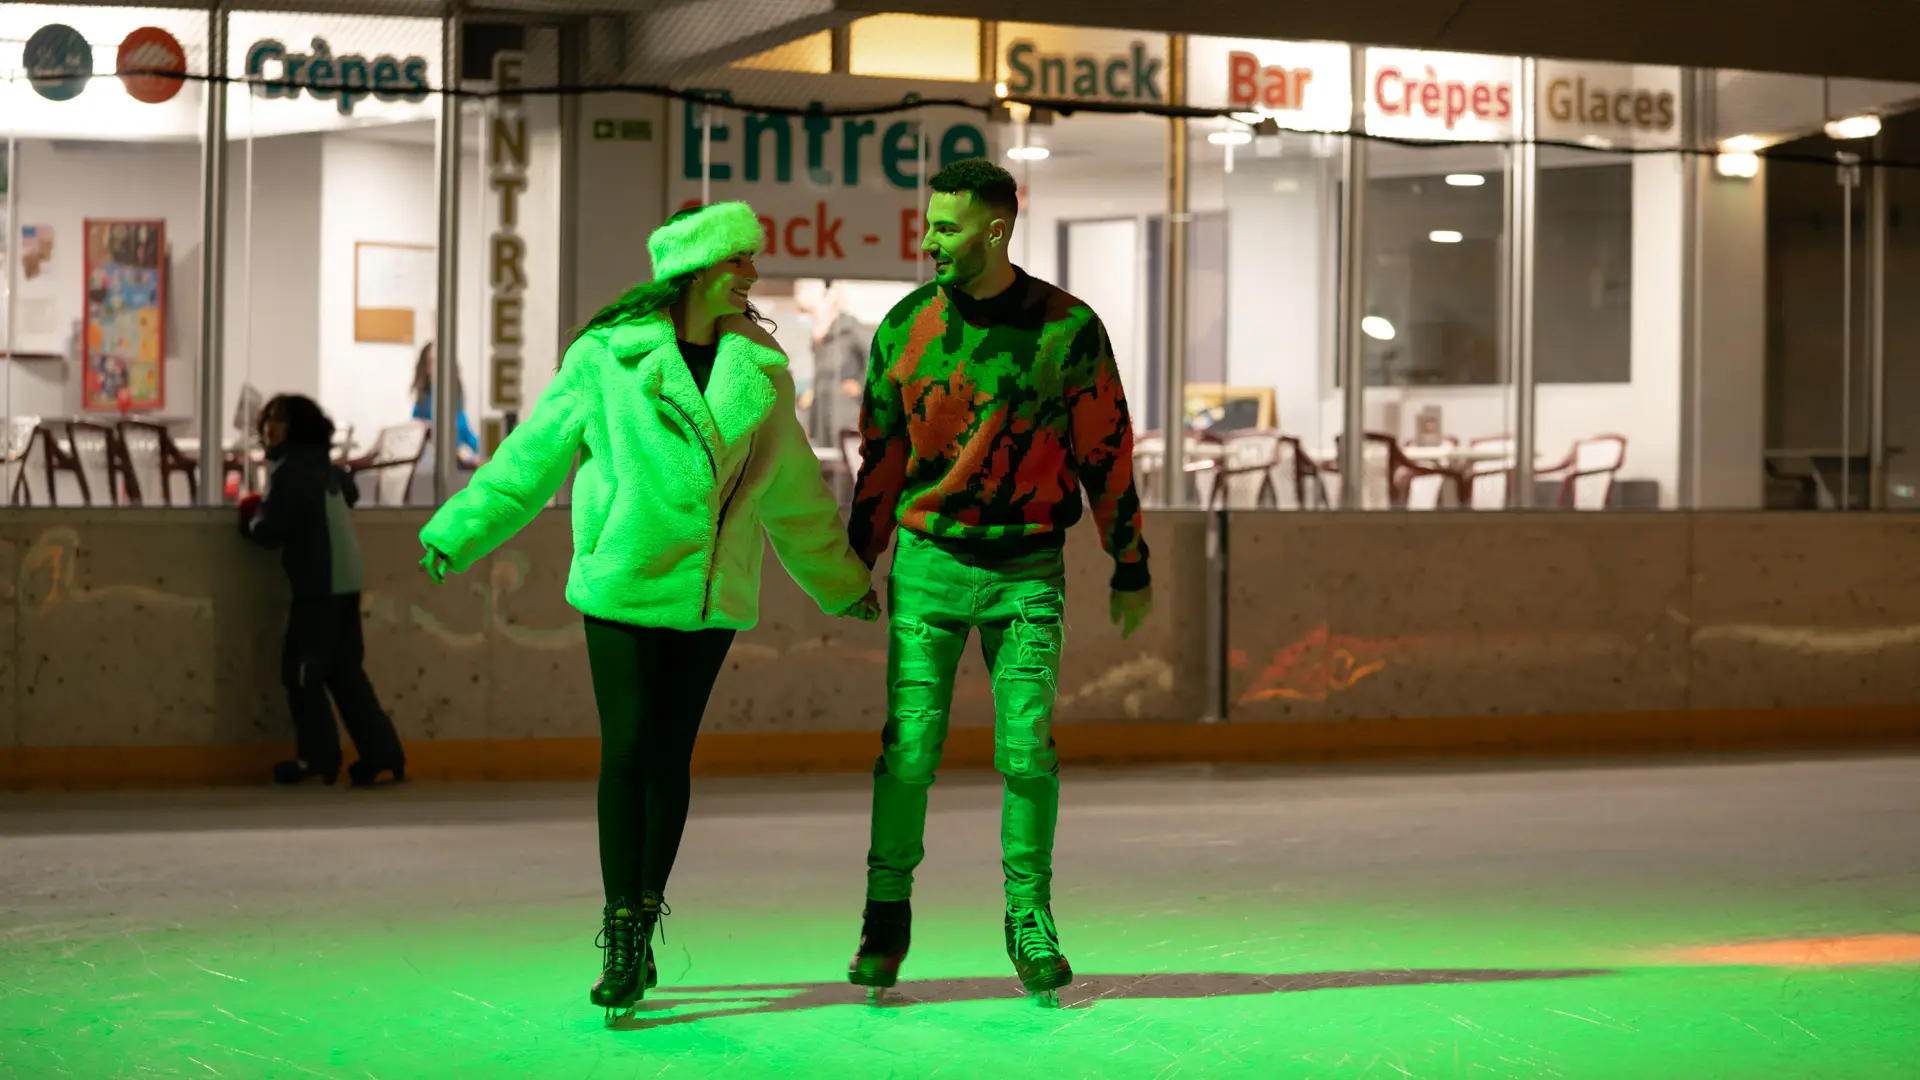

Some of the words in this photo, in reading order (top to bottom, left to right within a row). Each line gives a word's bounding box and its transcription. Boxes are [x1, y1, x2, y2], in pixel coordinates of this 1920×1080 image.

[1008, 40, 1160, 99] Snack
[1230, 52, 1312, 108] Bar
[1548, 77, 1675, 130] Glaces
